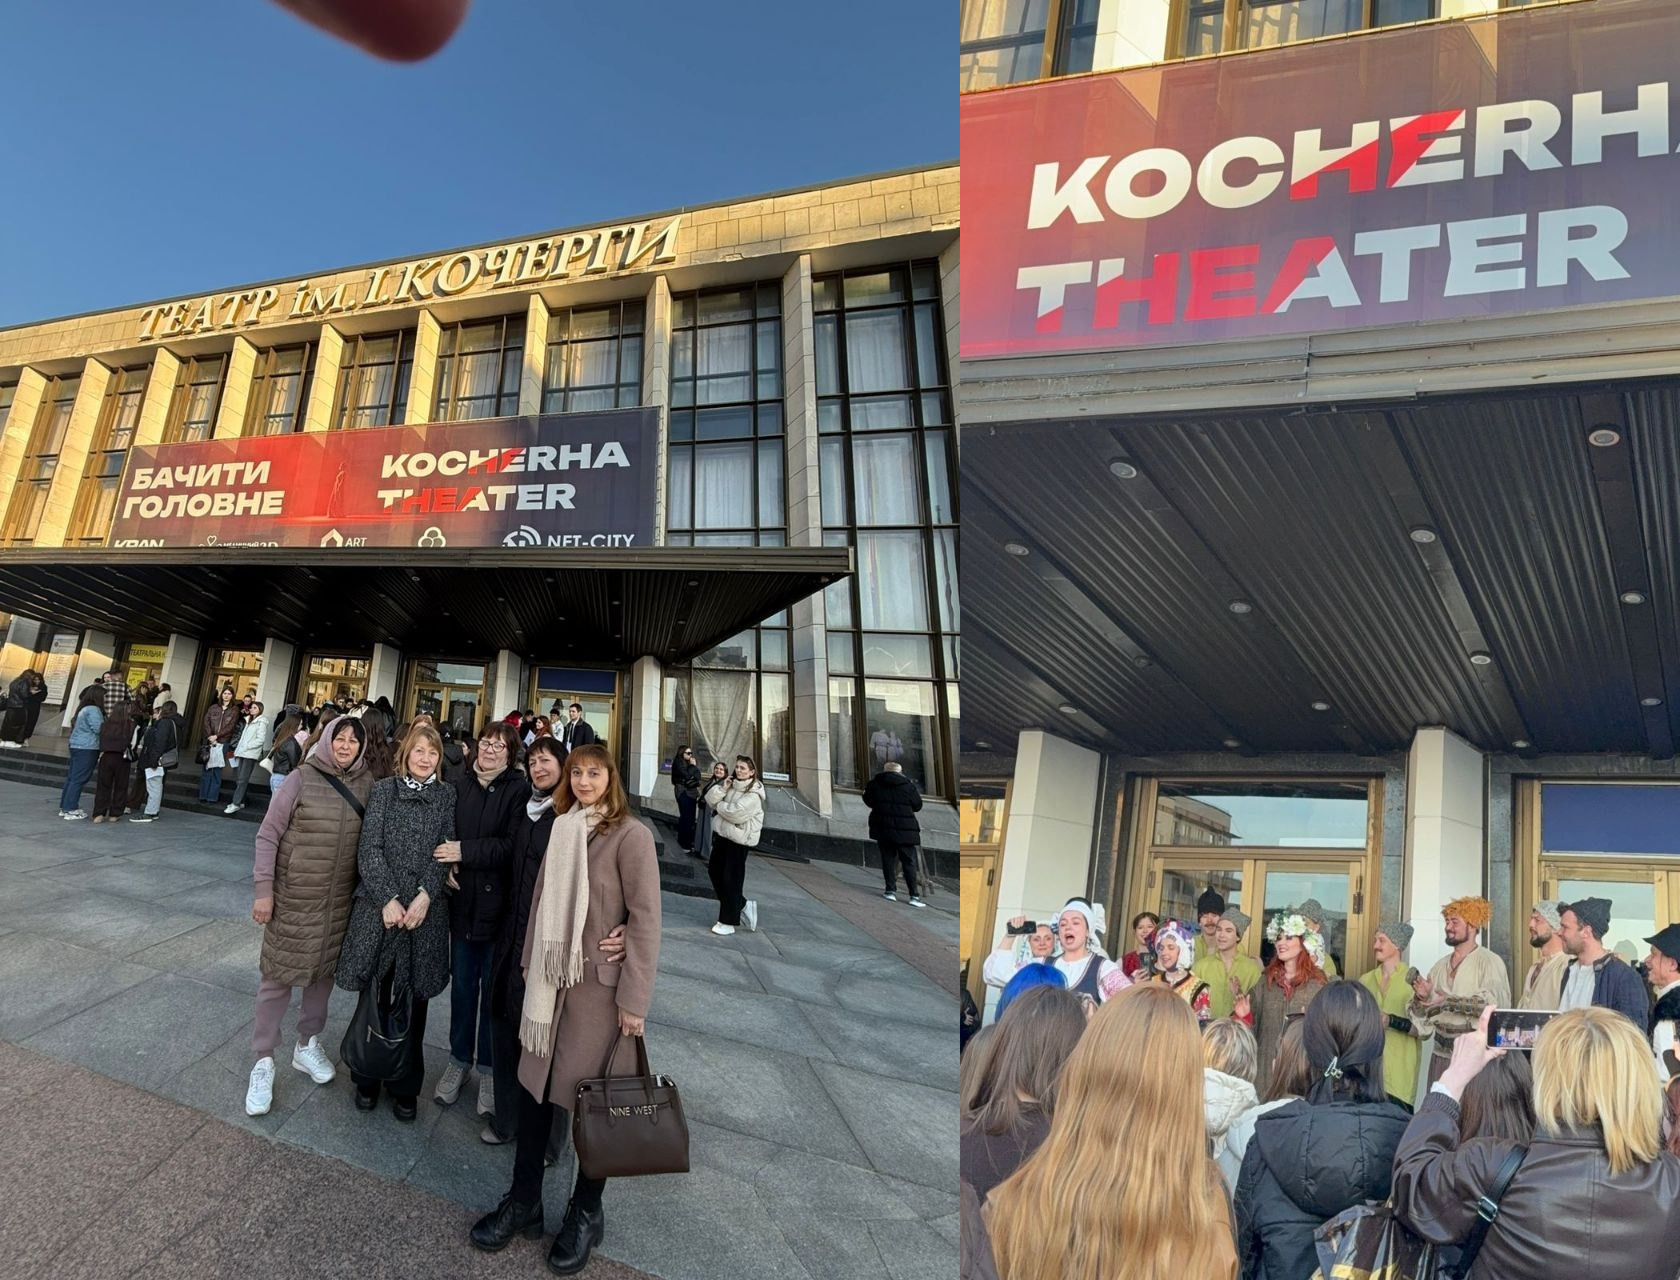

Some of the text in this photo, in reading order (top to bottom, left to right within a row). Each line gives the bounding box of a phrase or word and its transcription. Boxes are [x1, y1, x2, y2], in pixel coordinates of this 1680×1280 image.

[1027, 81, 1680, 229] KOCHERH
[1016, 204, 1631, 334] THEATER
[139, 287, 279, 341] ТЕАТР
[131, 461, 272, 490] БАЧИТИ
[381, 441, 630, 479] KOCHERHA
[122, 490, 285, 519] ГОЛОВНЕ
[377, 483, 576, 513] THEATER
[609, 1104, 658, 1117] NINE WEST
